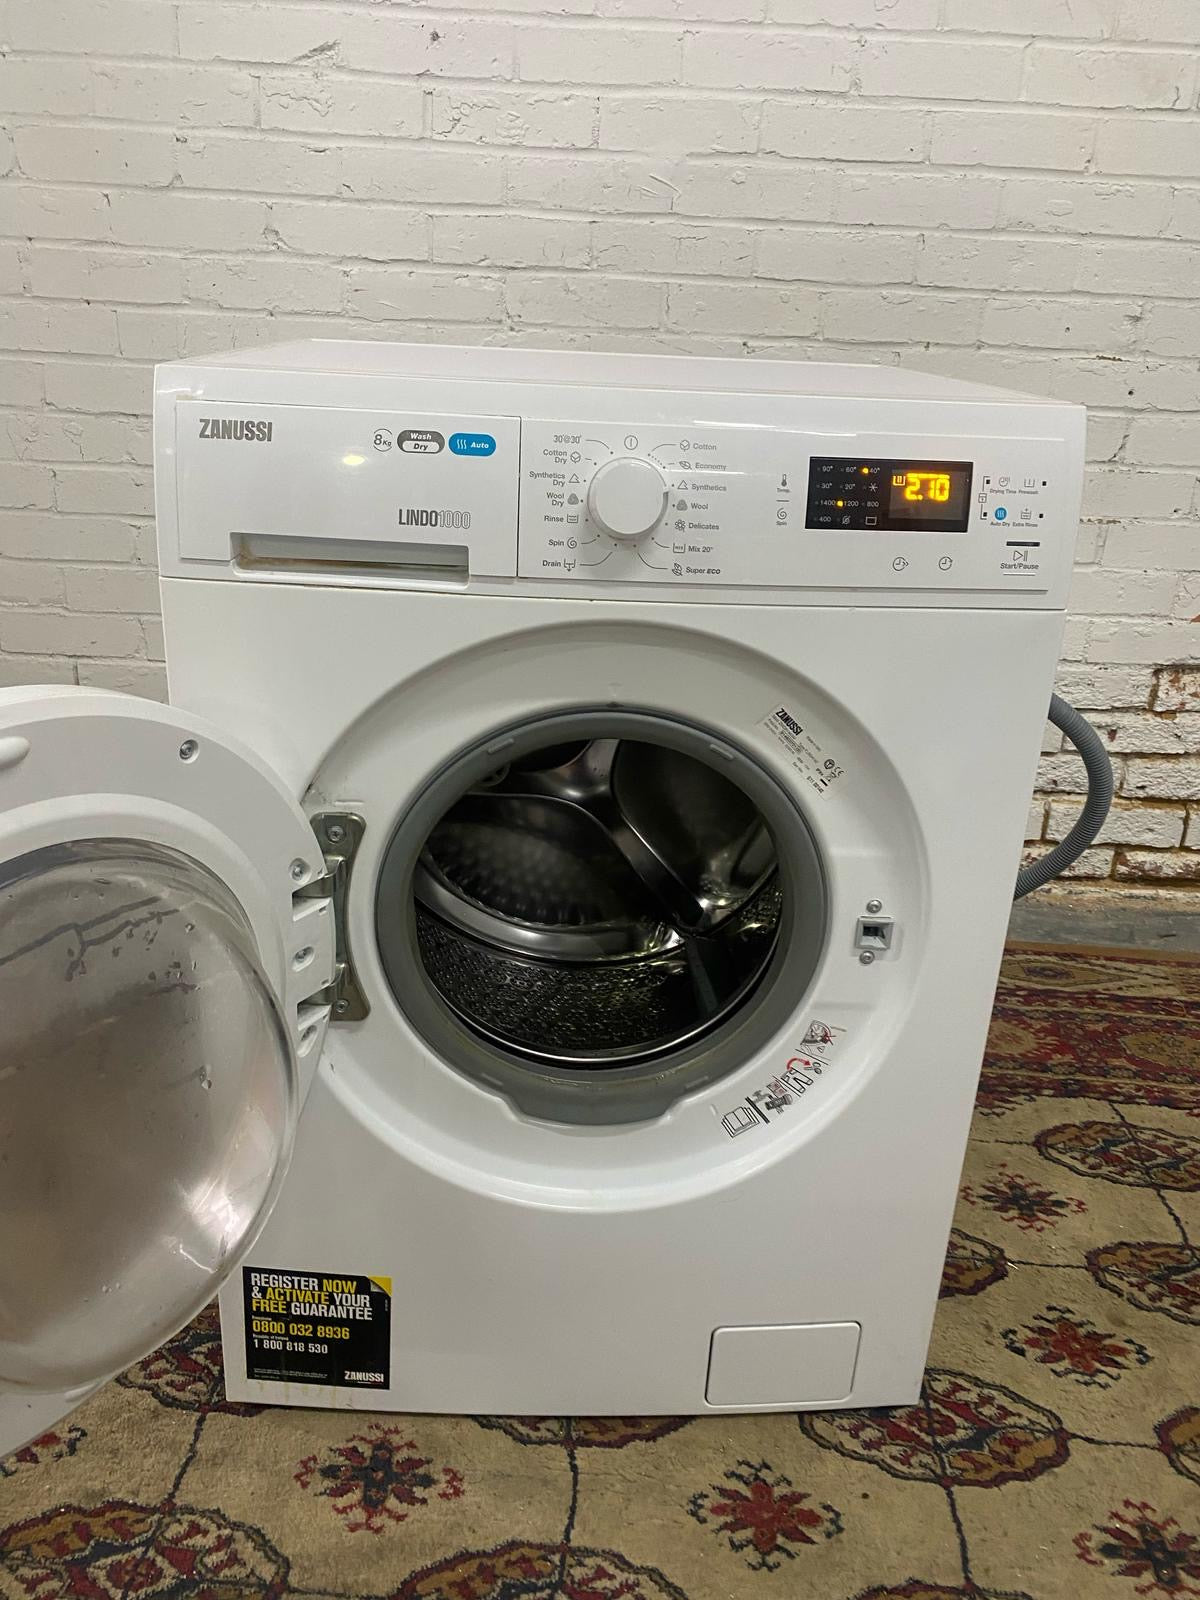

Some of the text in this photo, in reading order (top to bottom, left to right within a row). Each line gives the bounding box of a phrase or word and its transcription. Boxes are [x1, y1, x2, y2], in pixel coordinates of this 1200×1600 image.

[199, 418, 273, 442] ZANUSSI
[410, 432, 432, 441] Wash
[413, 443, 429, 452] Dry
[470, 441, 490, 449] Auto
[692, 443, 717, 451] Cotton
[543, 449, 567, 457] Cotton
[554, 456, 567, 464] Dry
[695, 462, 727, 471] Economy
[529, 471, 566, 480] Synthetics
[552, 478, 566, 487] Dry
[691, 483, 727, 492] Synthetics
[546, 492, 565, 500] Wool
[551, 499, 565, 507] Dry
[690, 502, 709, 510] Wool
[398, 508, 471, 530] LINDO1000
[543, 515, 565, 523] Rinse
[688, 522, 720, 530] Delicates
[548, 538, 565, 548] Spin
[542, 560, 562, 568] Drain
[1000, 562, 1040, 570] Start/Pause
[685, 566, 706, 575] Super
[775, 707, 804, 736] ZANUSSI
[250, 1272, 357, 1294] REGISTER NOW
[251, 1285, 263, 1299] &
[265, 1288, 330, 1305] ACTIVATE
[333, 1292, 371, 1308] YOUR
[251, 1299, 287, 1314] FREE
[290, 1301, 373, 1321] GUARANTEE
[252, 1320, 350, 1340] 0800 032 8936
[253, 1338, 328, 1355] 1 800 818 530
[344, 1369, 385, 1383] ZANUSSI
